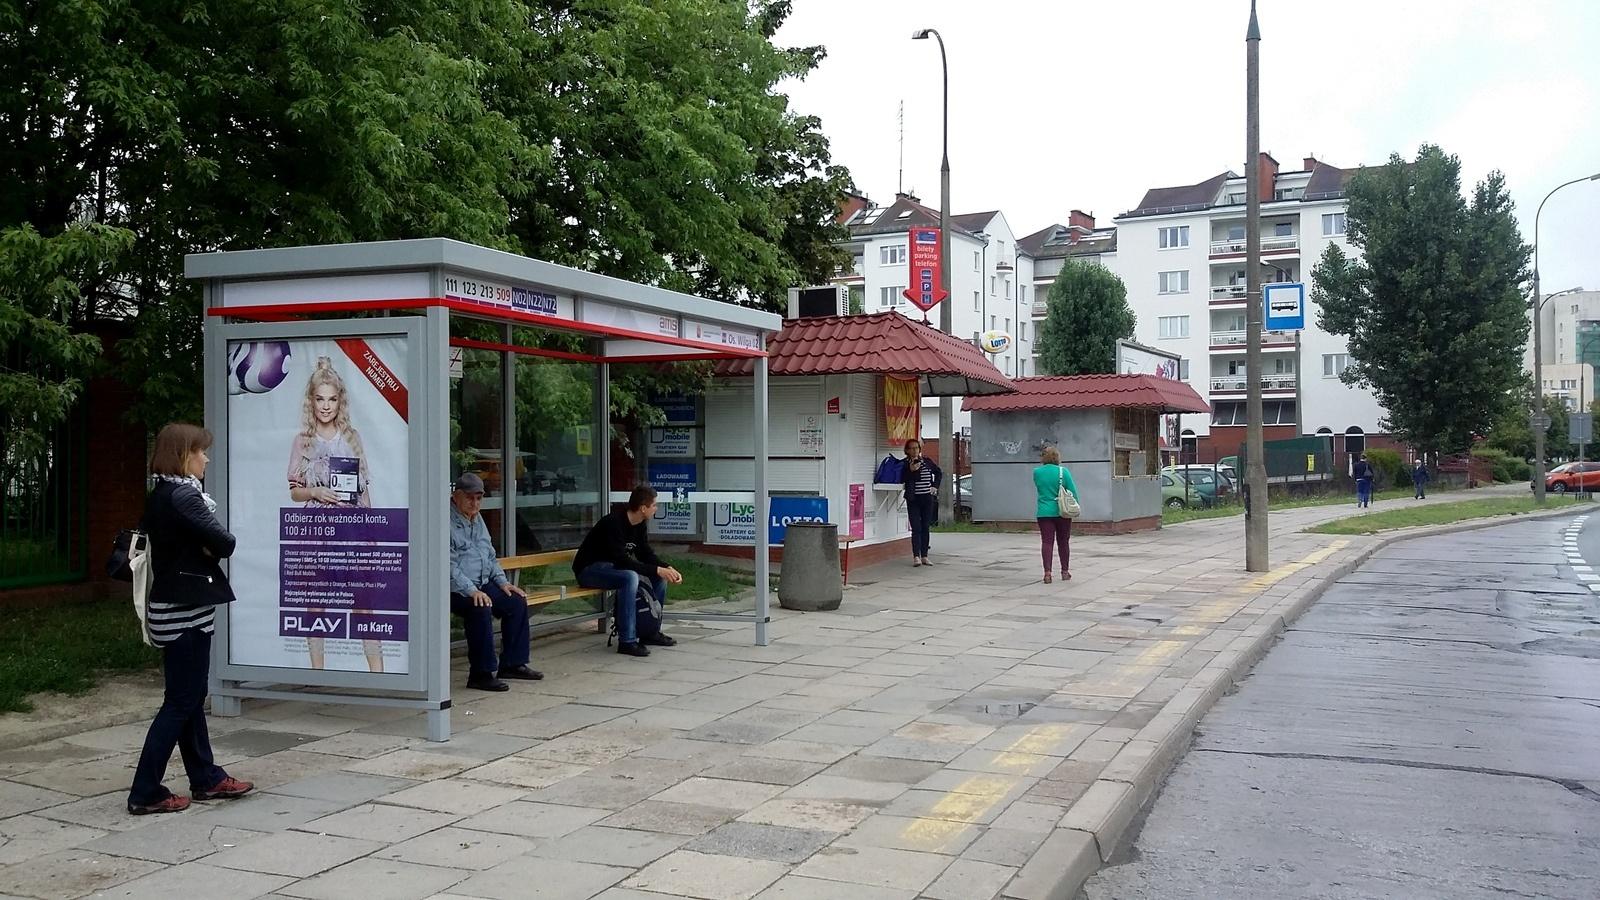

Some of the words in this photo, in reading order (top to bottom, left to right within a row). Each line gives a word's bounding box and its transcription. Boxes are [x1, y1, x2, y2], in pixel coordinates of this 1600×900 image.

[446, 278, 458, 292] 111
[462, 281, 476, 295] 123
[480, 284, 493, 298] 213
[496, 288, 510, 302] 509
[512, 290, 527, 305] N02
[528, 293, 542, 308] N22
[543, 296, 557, 310] N72
[738, 335, 752, 349] Wilga
[363, 350, 400, 392] ZAREJESTRUJ
[366, 366, 386, 390] NUMER
[732, 503, 755, 516] Lyc
[285, 513, 312, 523] Odbierz
[314, 513, 326, 523] rok
[328, 514, 363, 523] ważności
[366, 514, 388, 525] konta,
[285, 526, 299, 536] 100
[300, 526, 307, 536] zł
[314, 527, 323, 536] 10
[324, 527, 336, 536] GB
[284, 616, 342, 632] PLAY
[358, 623, 368, 632] na
[370, 622, 393, 635] Kartę
